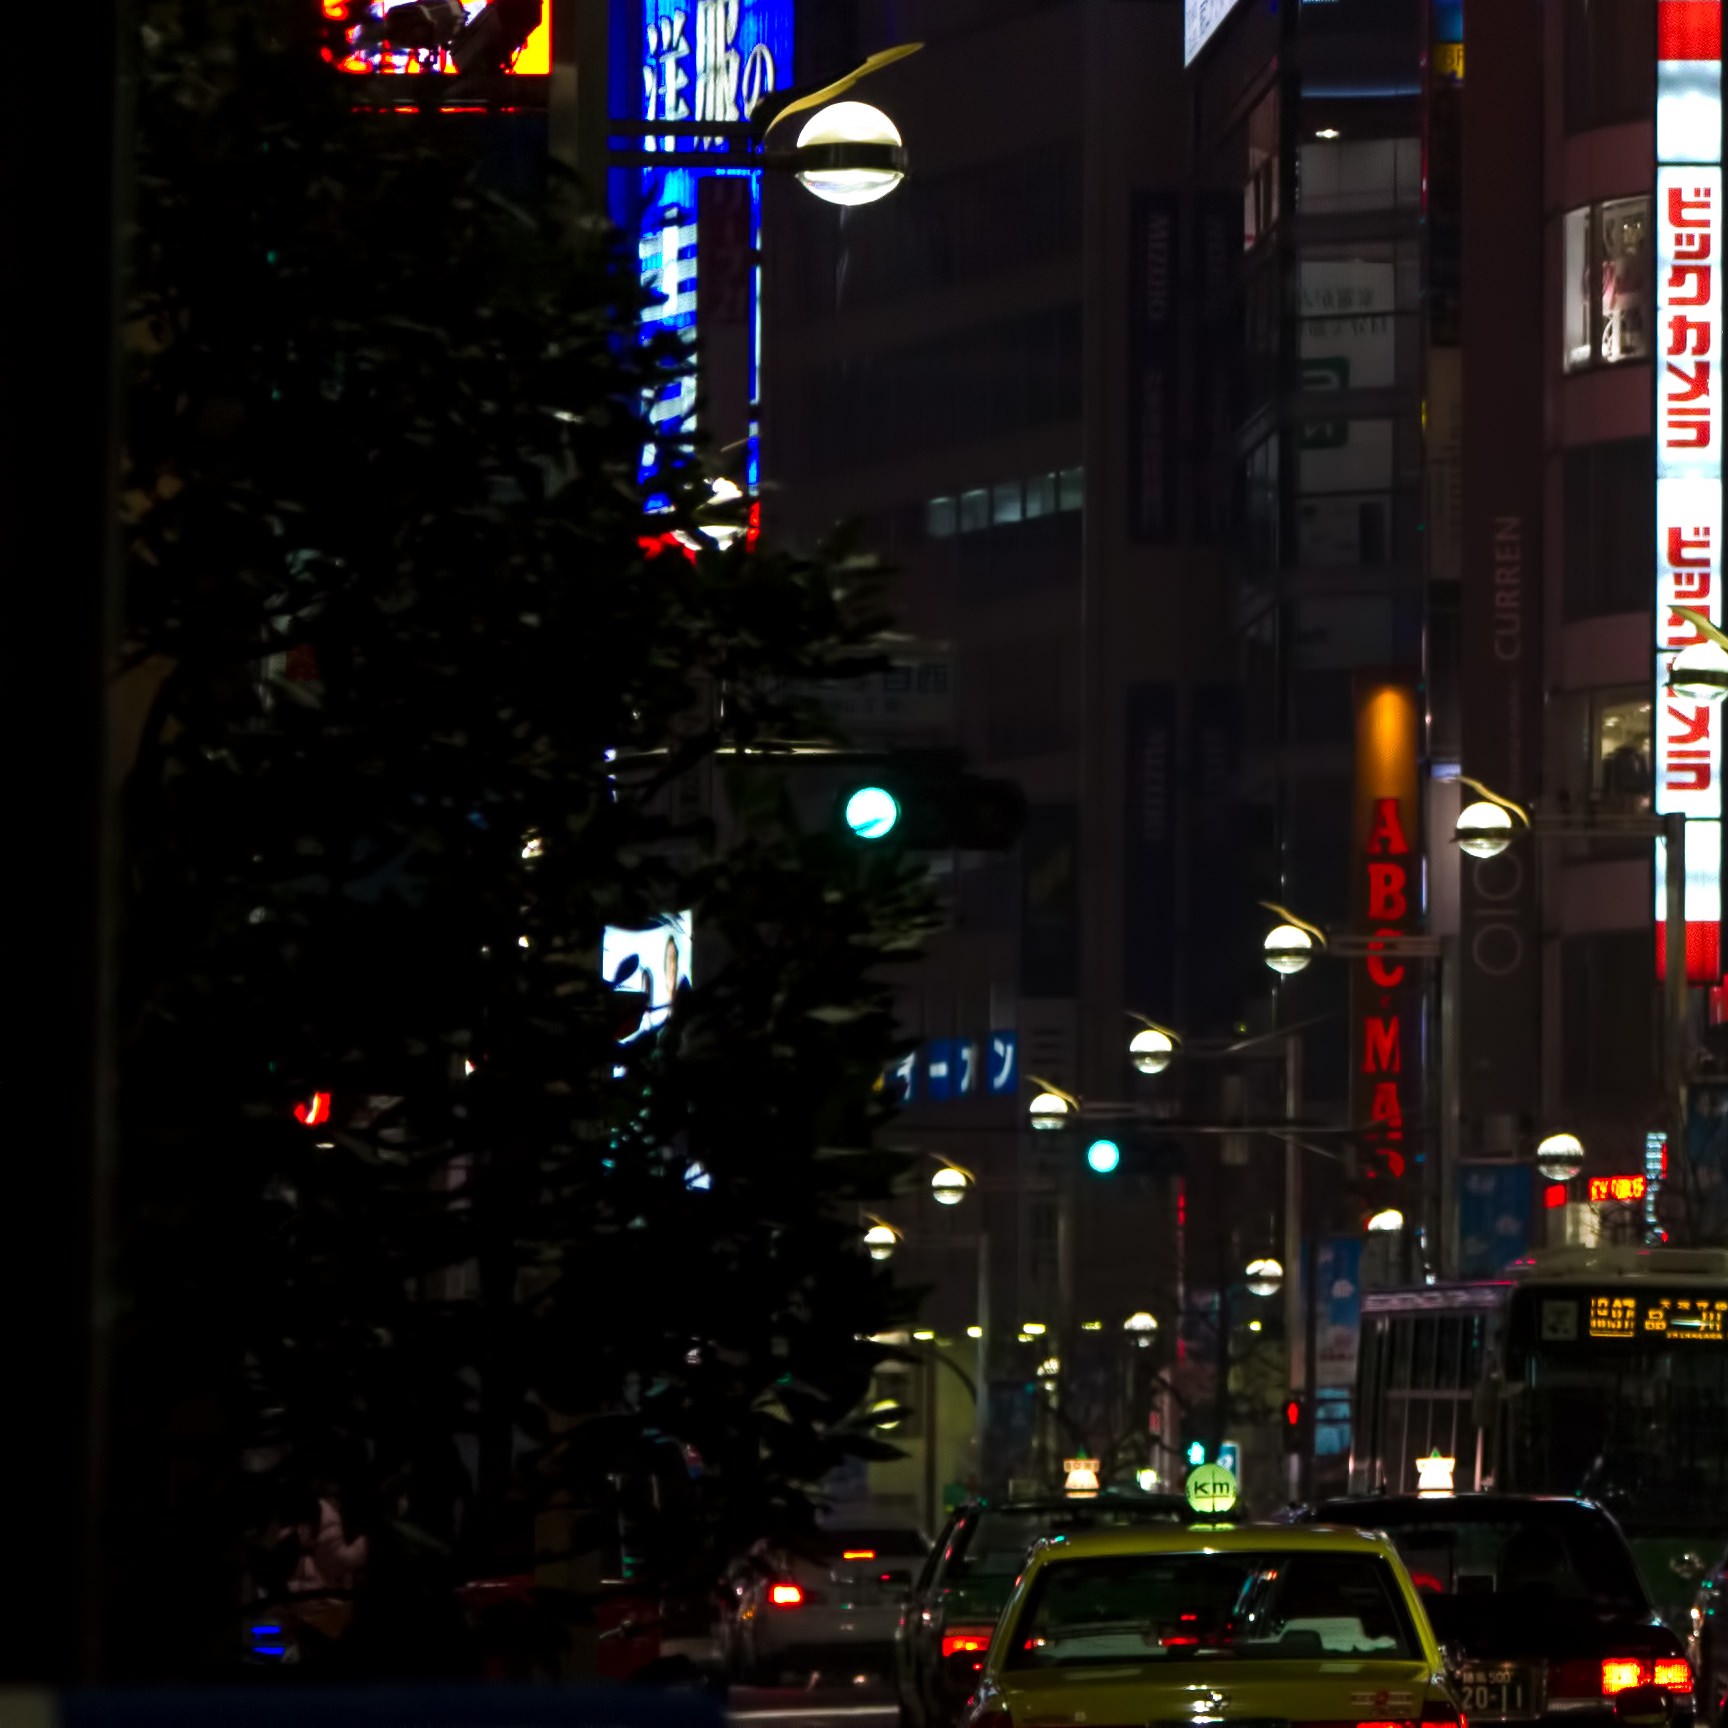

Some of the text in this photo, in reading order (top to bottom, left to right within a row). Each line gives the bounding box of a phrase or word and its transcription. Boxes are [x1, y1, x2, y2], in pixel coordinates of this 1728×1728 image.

[1666, 187, 1711, 448] ビックカメラ
